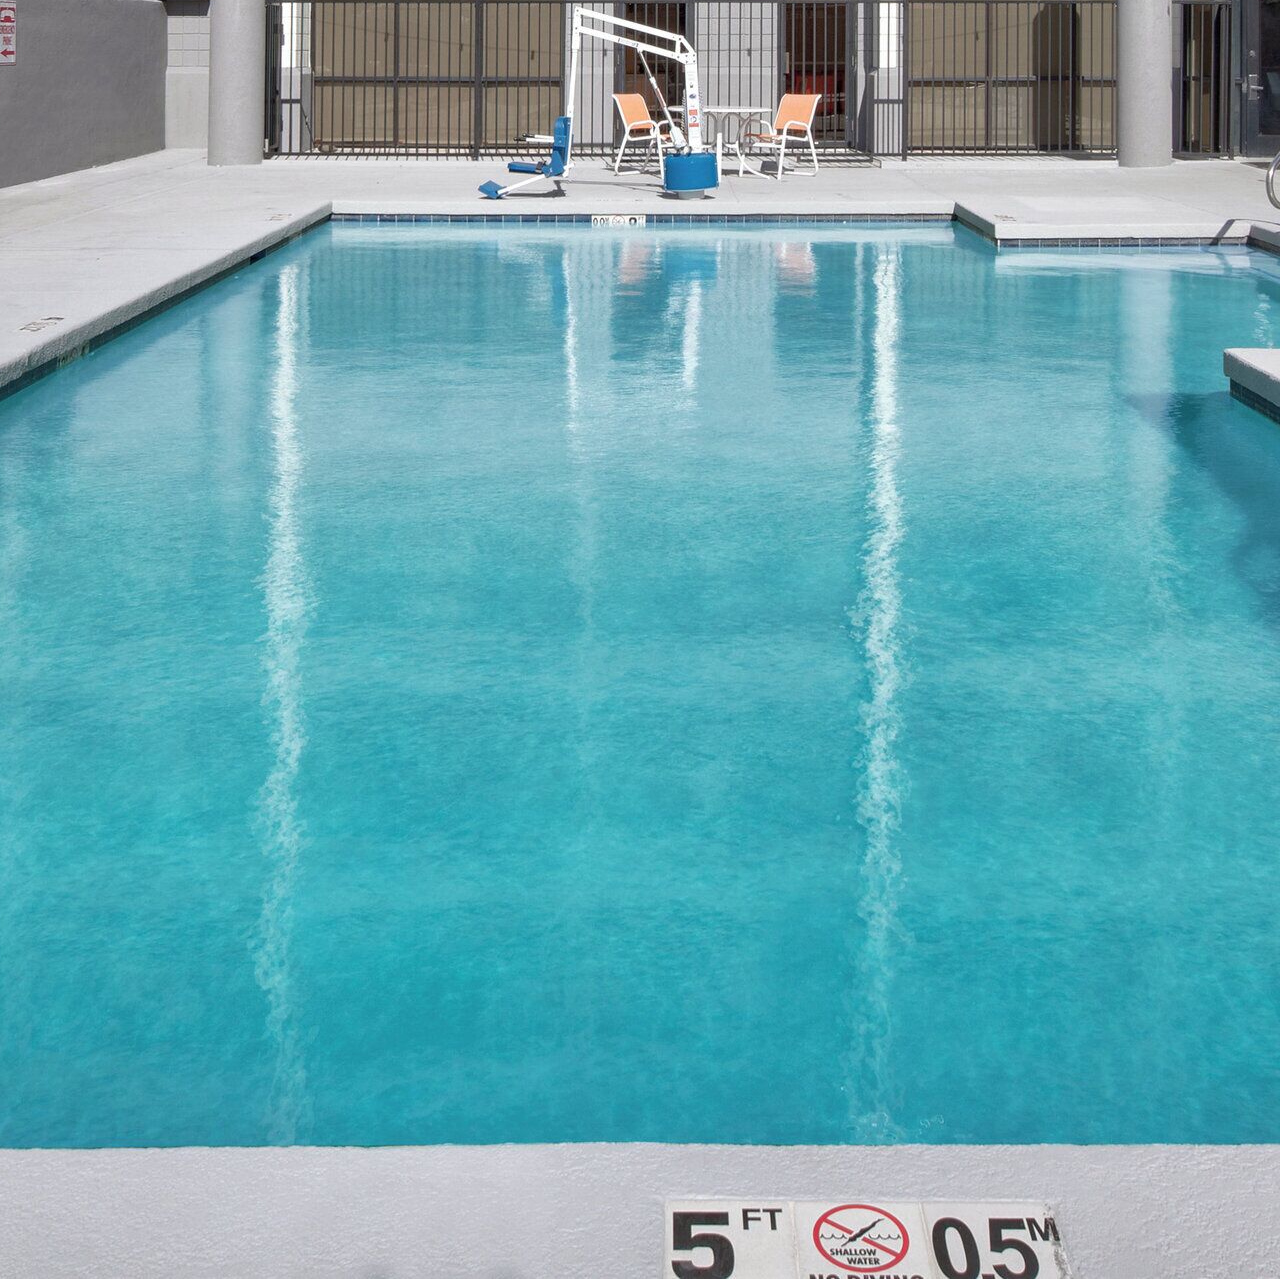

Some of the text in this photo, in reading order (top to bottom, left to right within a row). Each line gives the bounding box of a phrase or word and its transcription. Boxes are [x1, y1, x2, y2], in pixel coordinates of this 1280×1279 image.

[671, 1208, 783, 1279] 5 FT
[829, 1248, 877, 1257] SHALLOW
[846, 1257, 881, 1266] WATER
